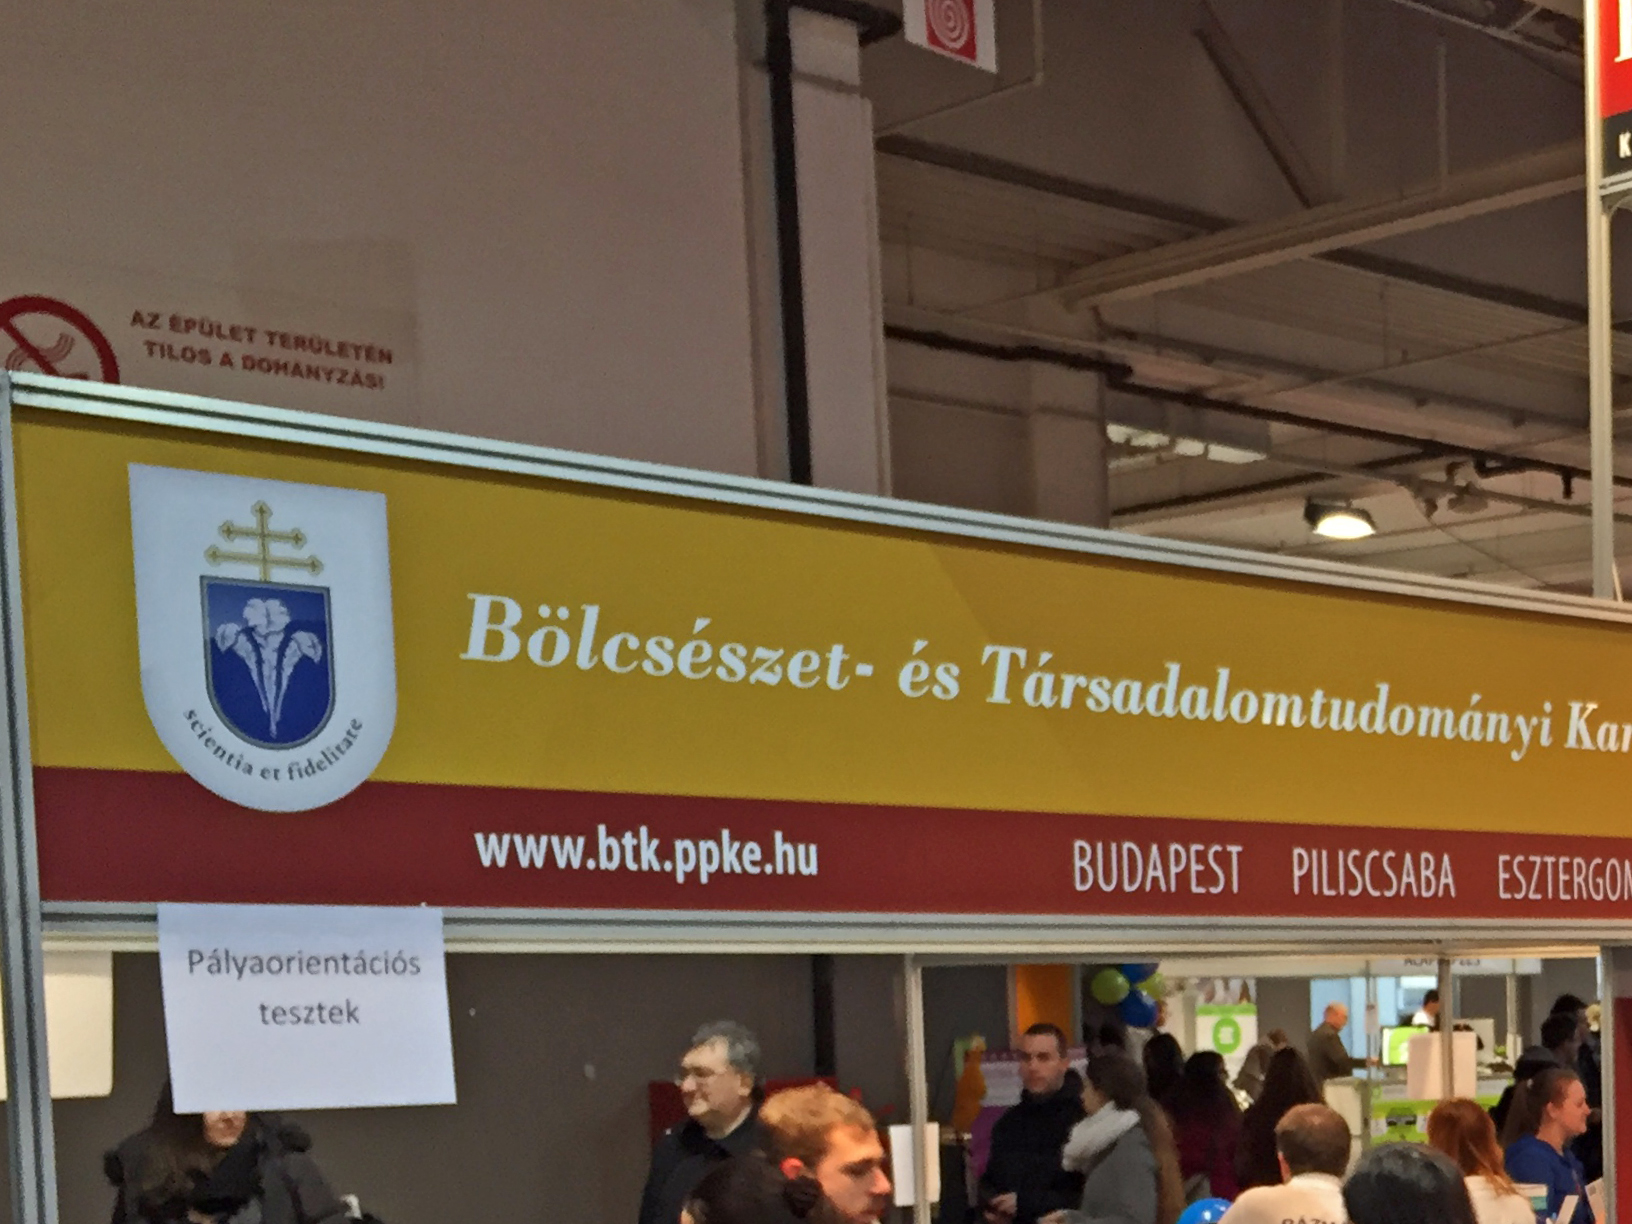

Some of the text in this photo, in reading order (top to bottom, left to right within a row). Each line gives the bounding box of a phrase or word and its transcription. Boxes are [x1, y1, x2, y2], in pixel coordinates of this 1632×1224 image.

[130, 309, 161, 329] AZ
[168, 312, 257, 343] ÉPÜLET
[143, 339, 212, 366] TILOS
[219, 351, 236, 369] A
[459, 592, 874, 691] Bölcsészet-
[898, 639, 961, 701] és
[981, 644, 1553, 762] Társadalomtudományi
[183, 709, 363, 781] scientia et fidelitate
[474, 824, 819, 885] www.btk.ppke.hu
[1072, 840, 1243, 895] BUDAPEST
[1292, 847, 1456, 899] PILISCSABA
[186, 947, 421, 982] Pályaorientációs
[259, 1000, 361, 1028] tesztek
